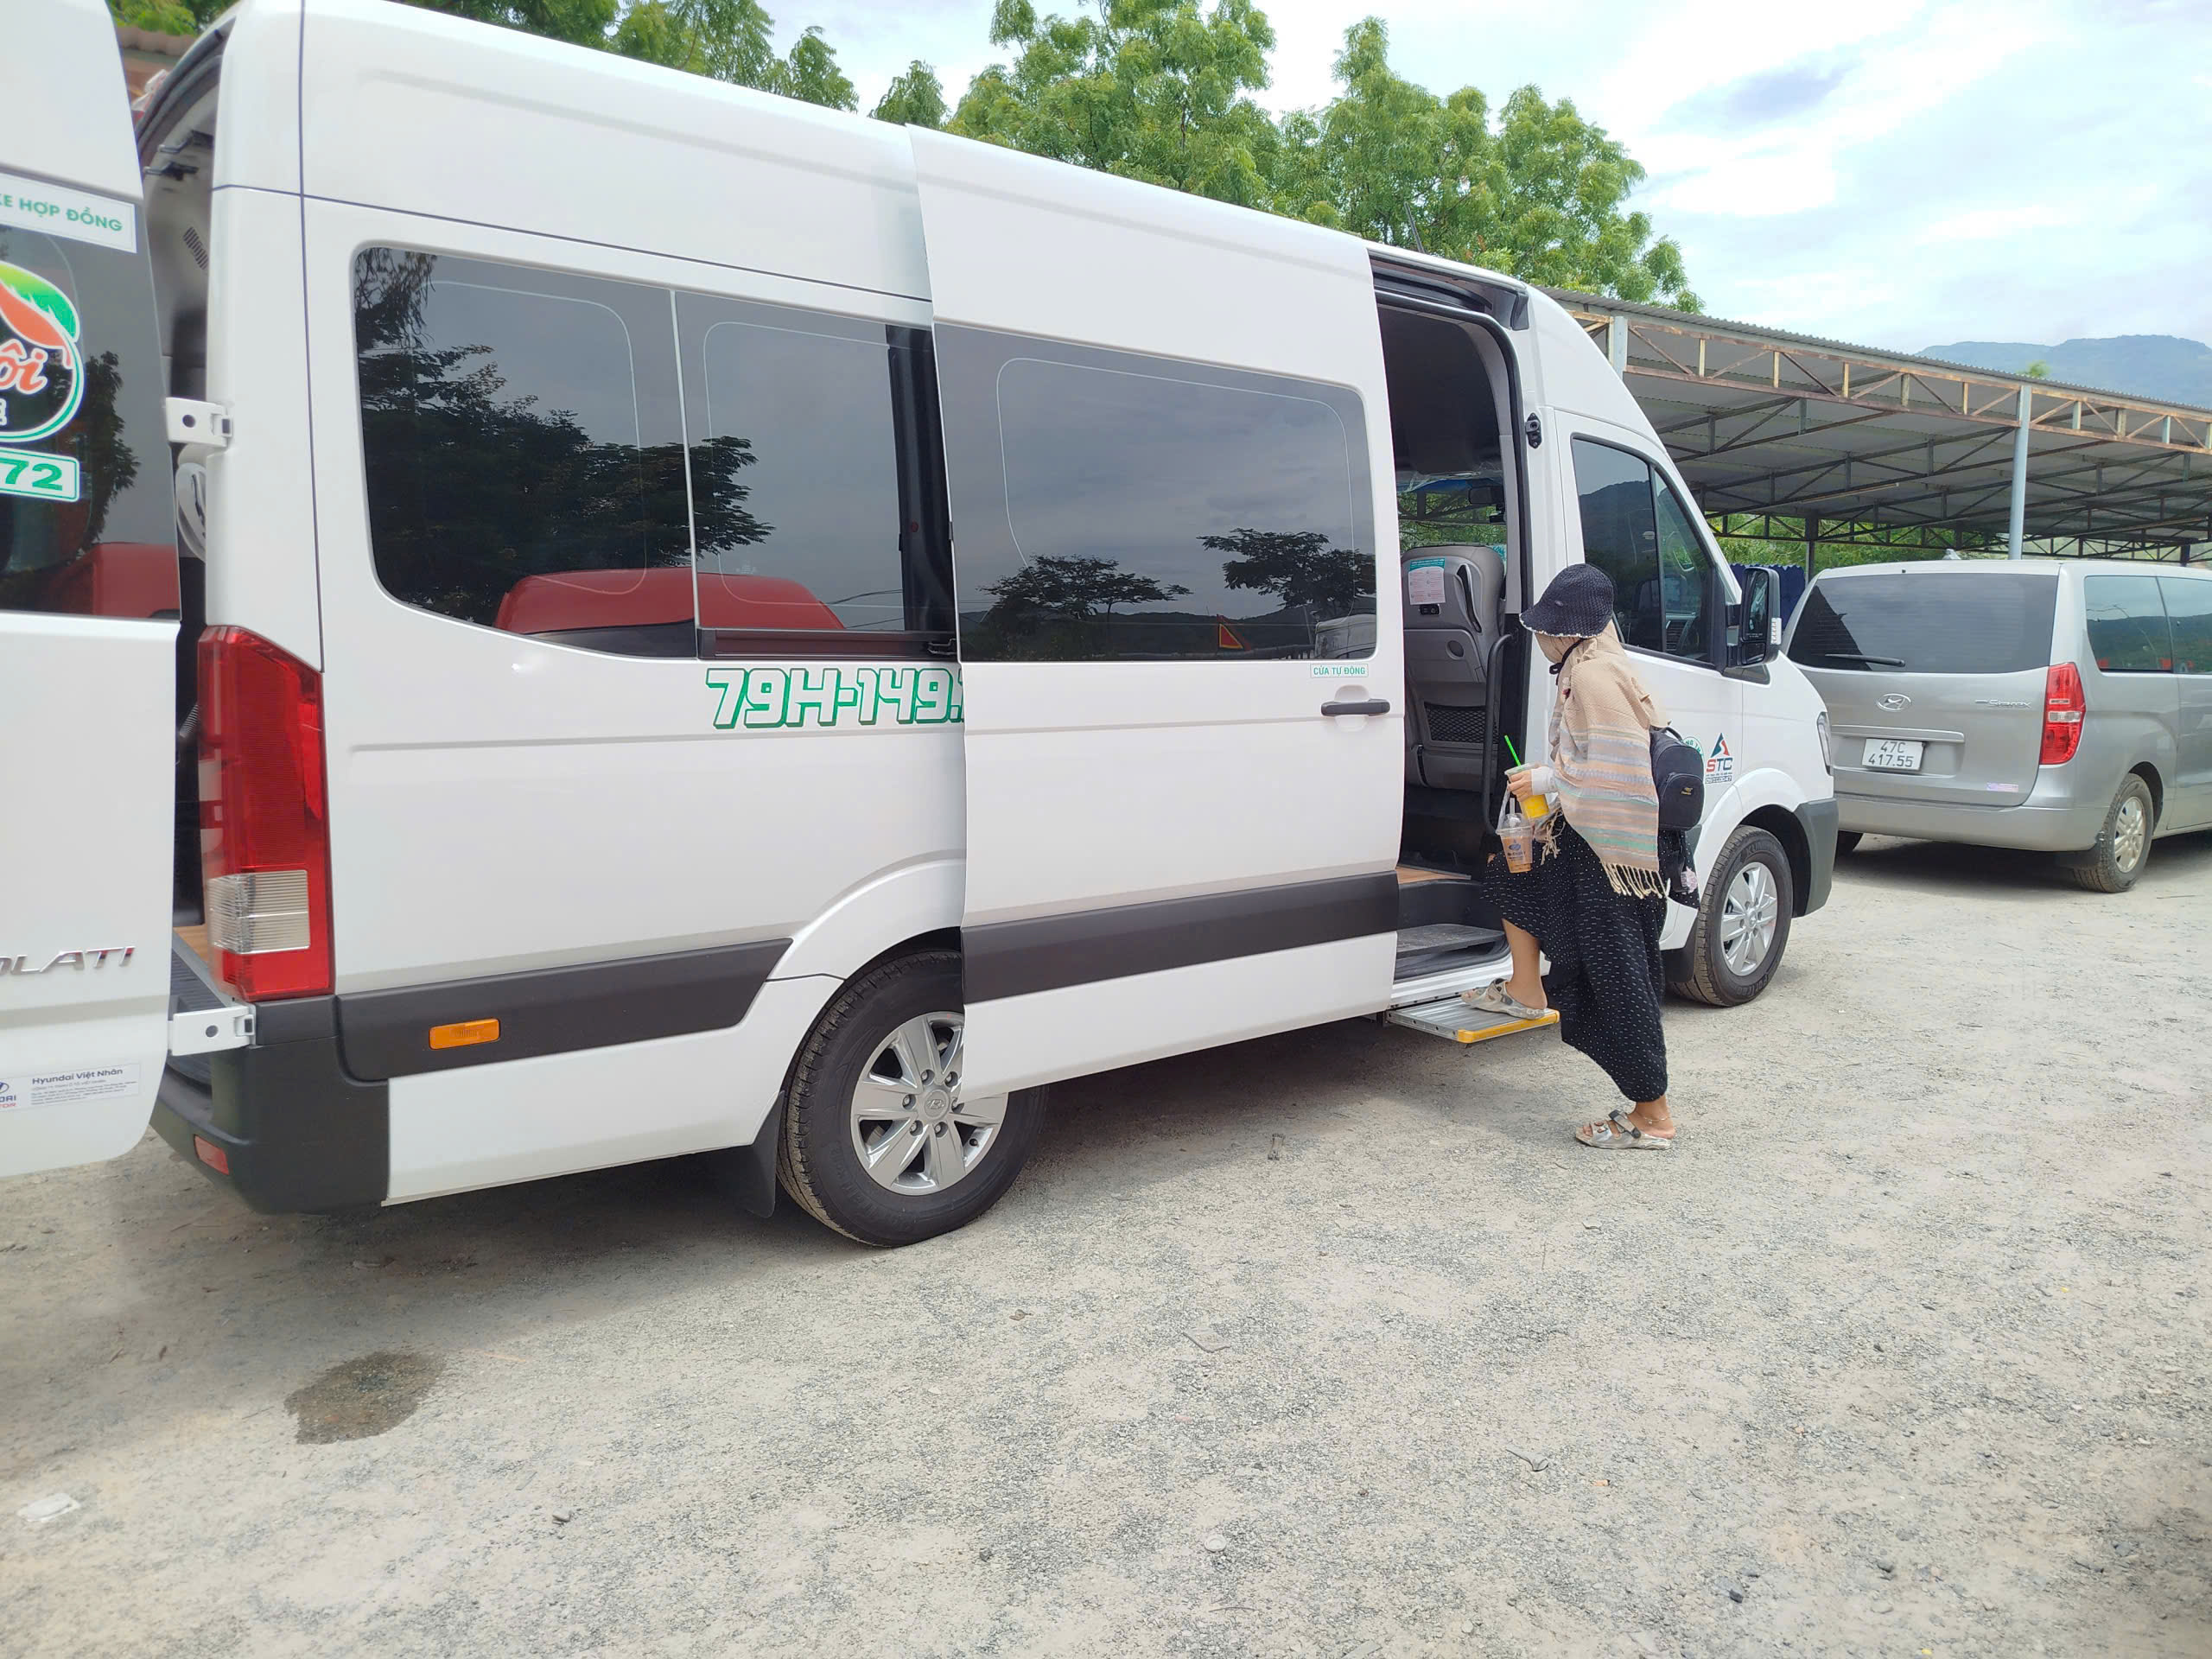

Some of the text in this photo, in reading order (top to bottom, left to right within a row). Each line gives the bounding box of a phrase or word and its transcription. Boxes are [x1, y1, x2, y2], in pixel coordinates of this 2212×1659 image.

[19, 198, 60, 218] HỢP
[1313, 665, 1365, 676] CỬA TỰ ĐỘNG
[706, 668, 964, 729] 79H-149.
[1880, 741, 1905, 753] 47C
[1707, 758, 1732, 772] STC
[1868, 753, 1914, 767] 417.55
[32, 1074, 74, 1084] Hyundai
[98, 1068, 123, 1077] Nhân
